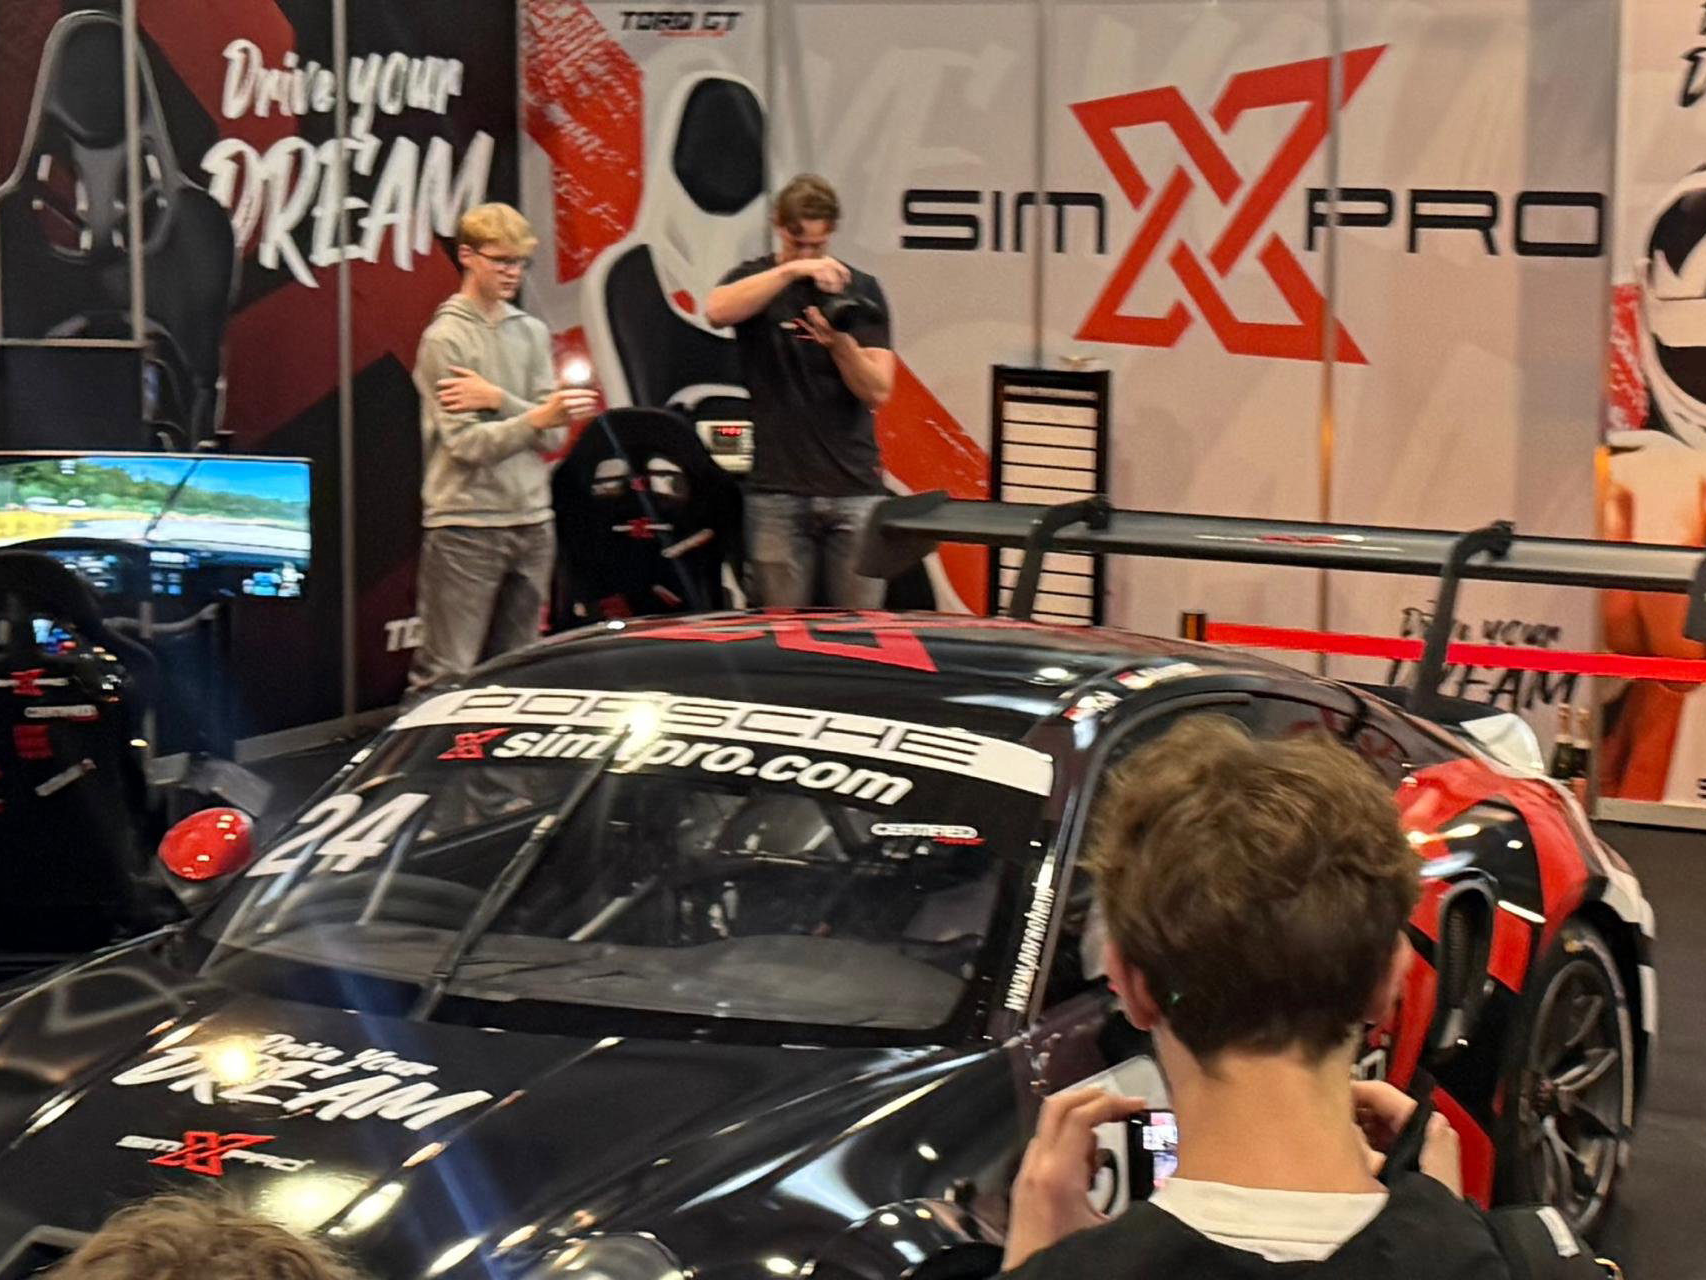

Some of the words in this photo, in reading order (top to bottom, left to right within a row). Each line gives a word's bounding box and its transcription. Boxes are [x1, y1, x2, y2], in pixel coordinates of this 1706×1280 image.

[222, 38, 335, 120] Drive
[343, 50, 463, 152] your
[200, 130, 495, 289] DREAM
[454, 692, 985, 767] PORSCHE
[246, 793, 429, 878] 24
